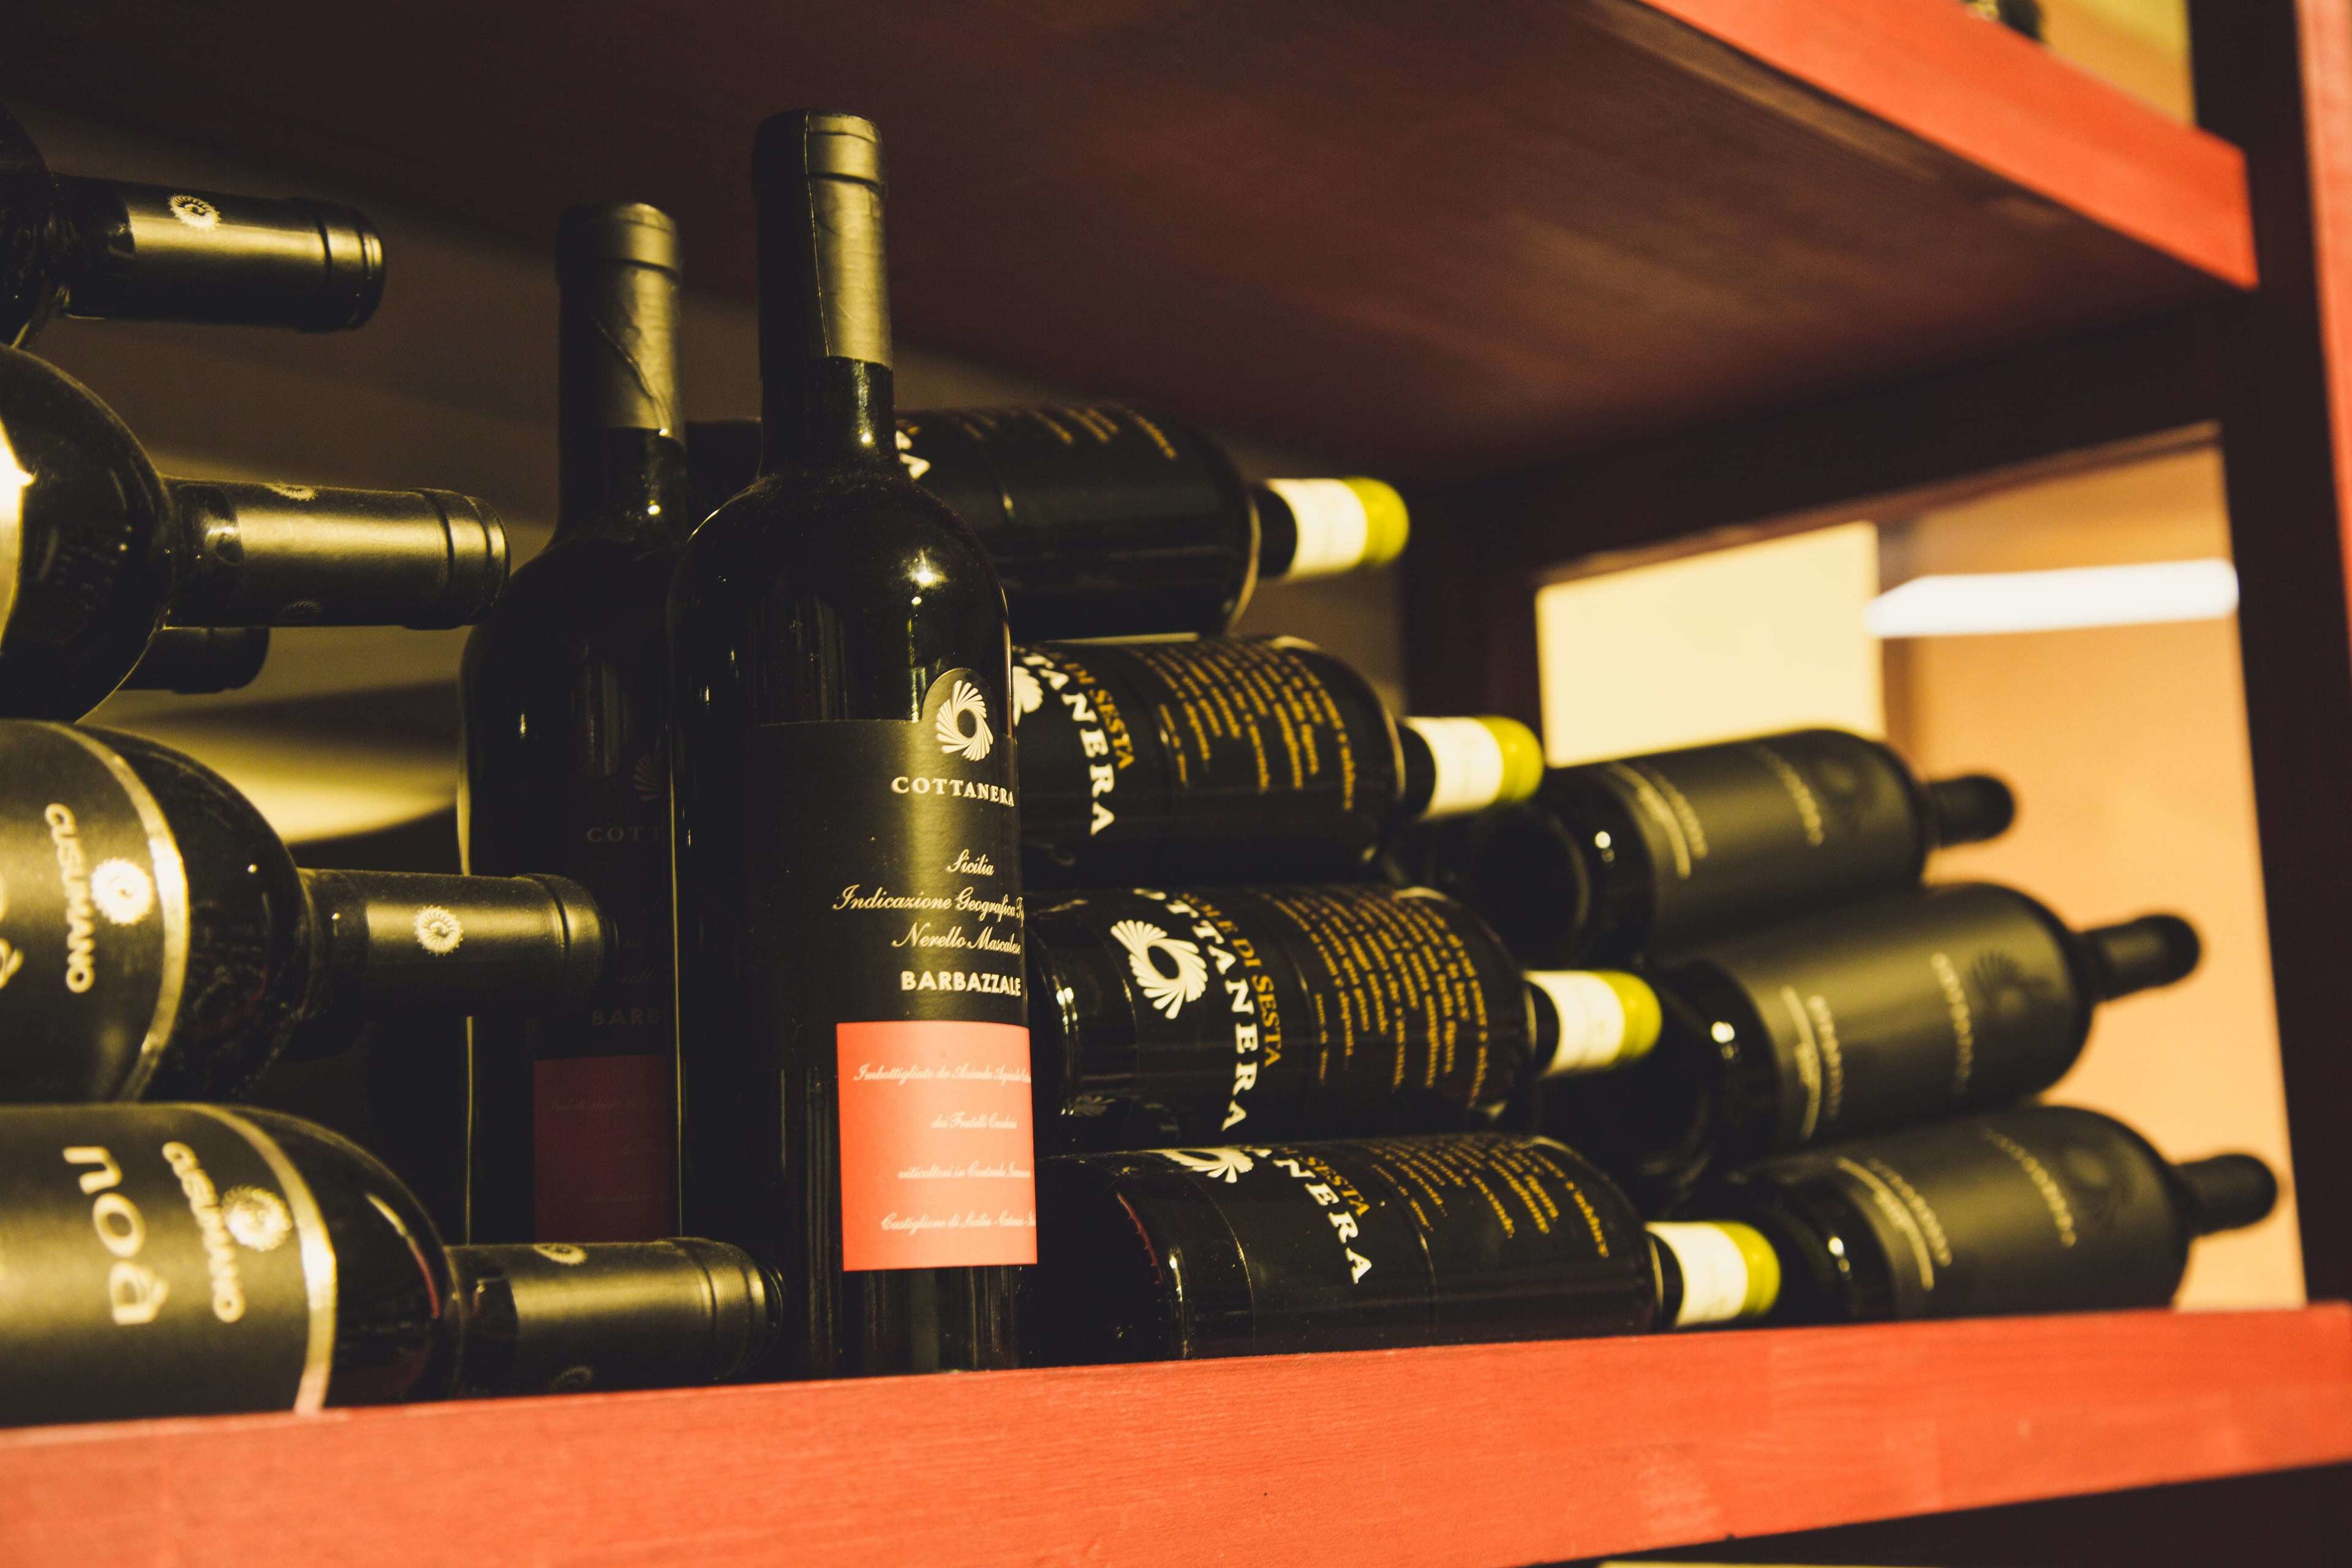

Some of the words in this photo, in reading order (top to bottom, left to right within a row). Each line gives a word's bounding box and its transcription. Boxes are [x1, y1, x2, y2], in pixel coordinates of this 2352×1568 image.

[891, 776, 1014, 807] COTTANERA
[946, 849, 995, 876] Sicilia
[832, 883, 951, 911] Indicazione
[953, 886, 1016, 924] Geografica
[891, 922, 967, 948] Nerello
[967, 926, 1021, 955] Mascalese
[900, 971, 1022, 997] BARBAZZALE
[1232, 937, 1262, 968] DI
[1252, 974, 1282, 1068] SESTA
[1298, 1156, 1371, 1218] SESTA
